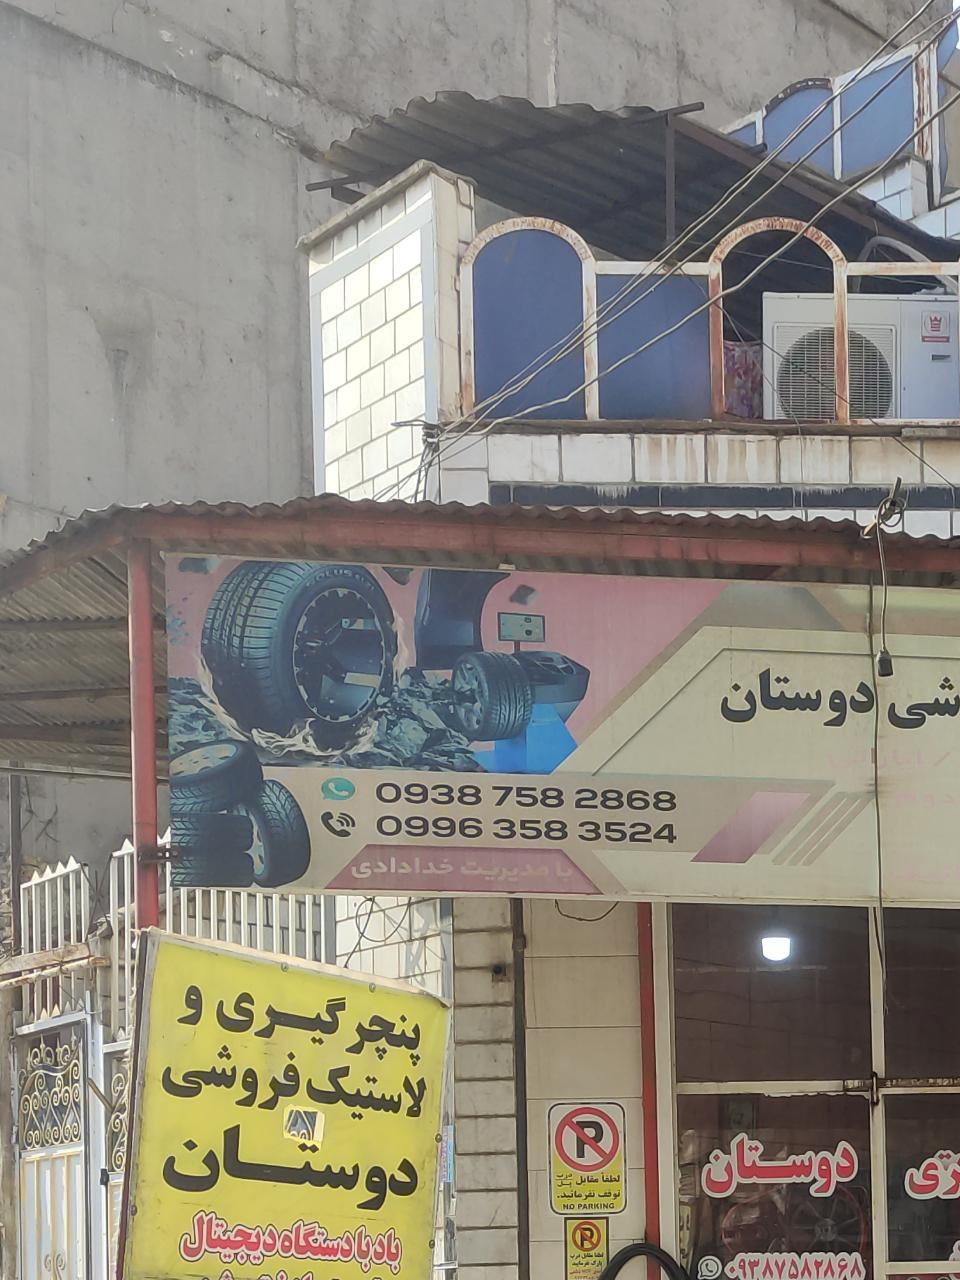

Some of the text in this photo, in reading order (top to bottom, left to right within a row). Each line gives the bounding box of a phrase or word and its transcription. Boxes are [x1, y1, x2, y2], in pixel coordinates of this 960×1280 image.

[720, 669, 876, 728] دوستان
[376, 782, 677, 812] 0938 758 2868
[376, 815, 677, 844] 0996 358 3524
[351, 856, 453, 880] خدادادی
[176, 984, 203, 1026] و
[161, 1044, 427, 1120] لاستیک فروشی
[162, 1123, 420, 1211] دوستان
[703, 1134, 857, 1196] دوستان
[181, 1211, 401, 1273] باد با دستگاه دیجیتال
